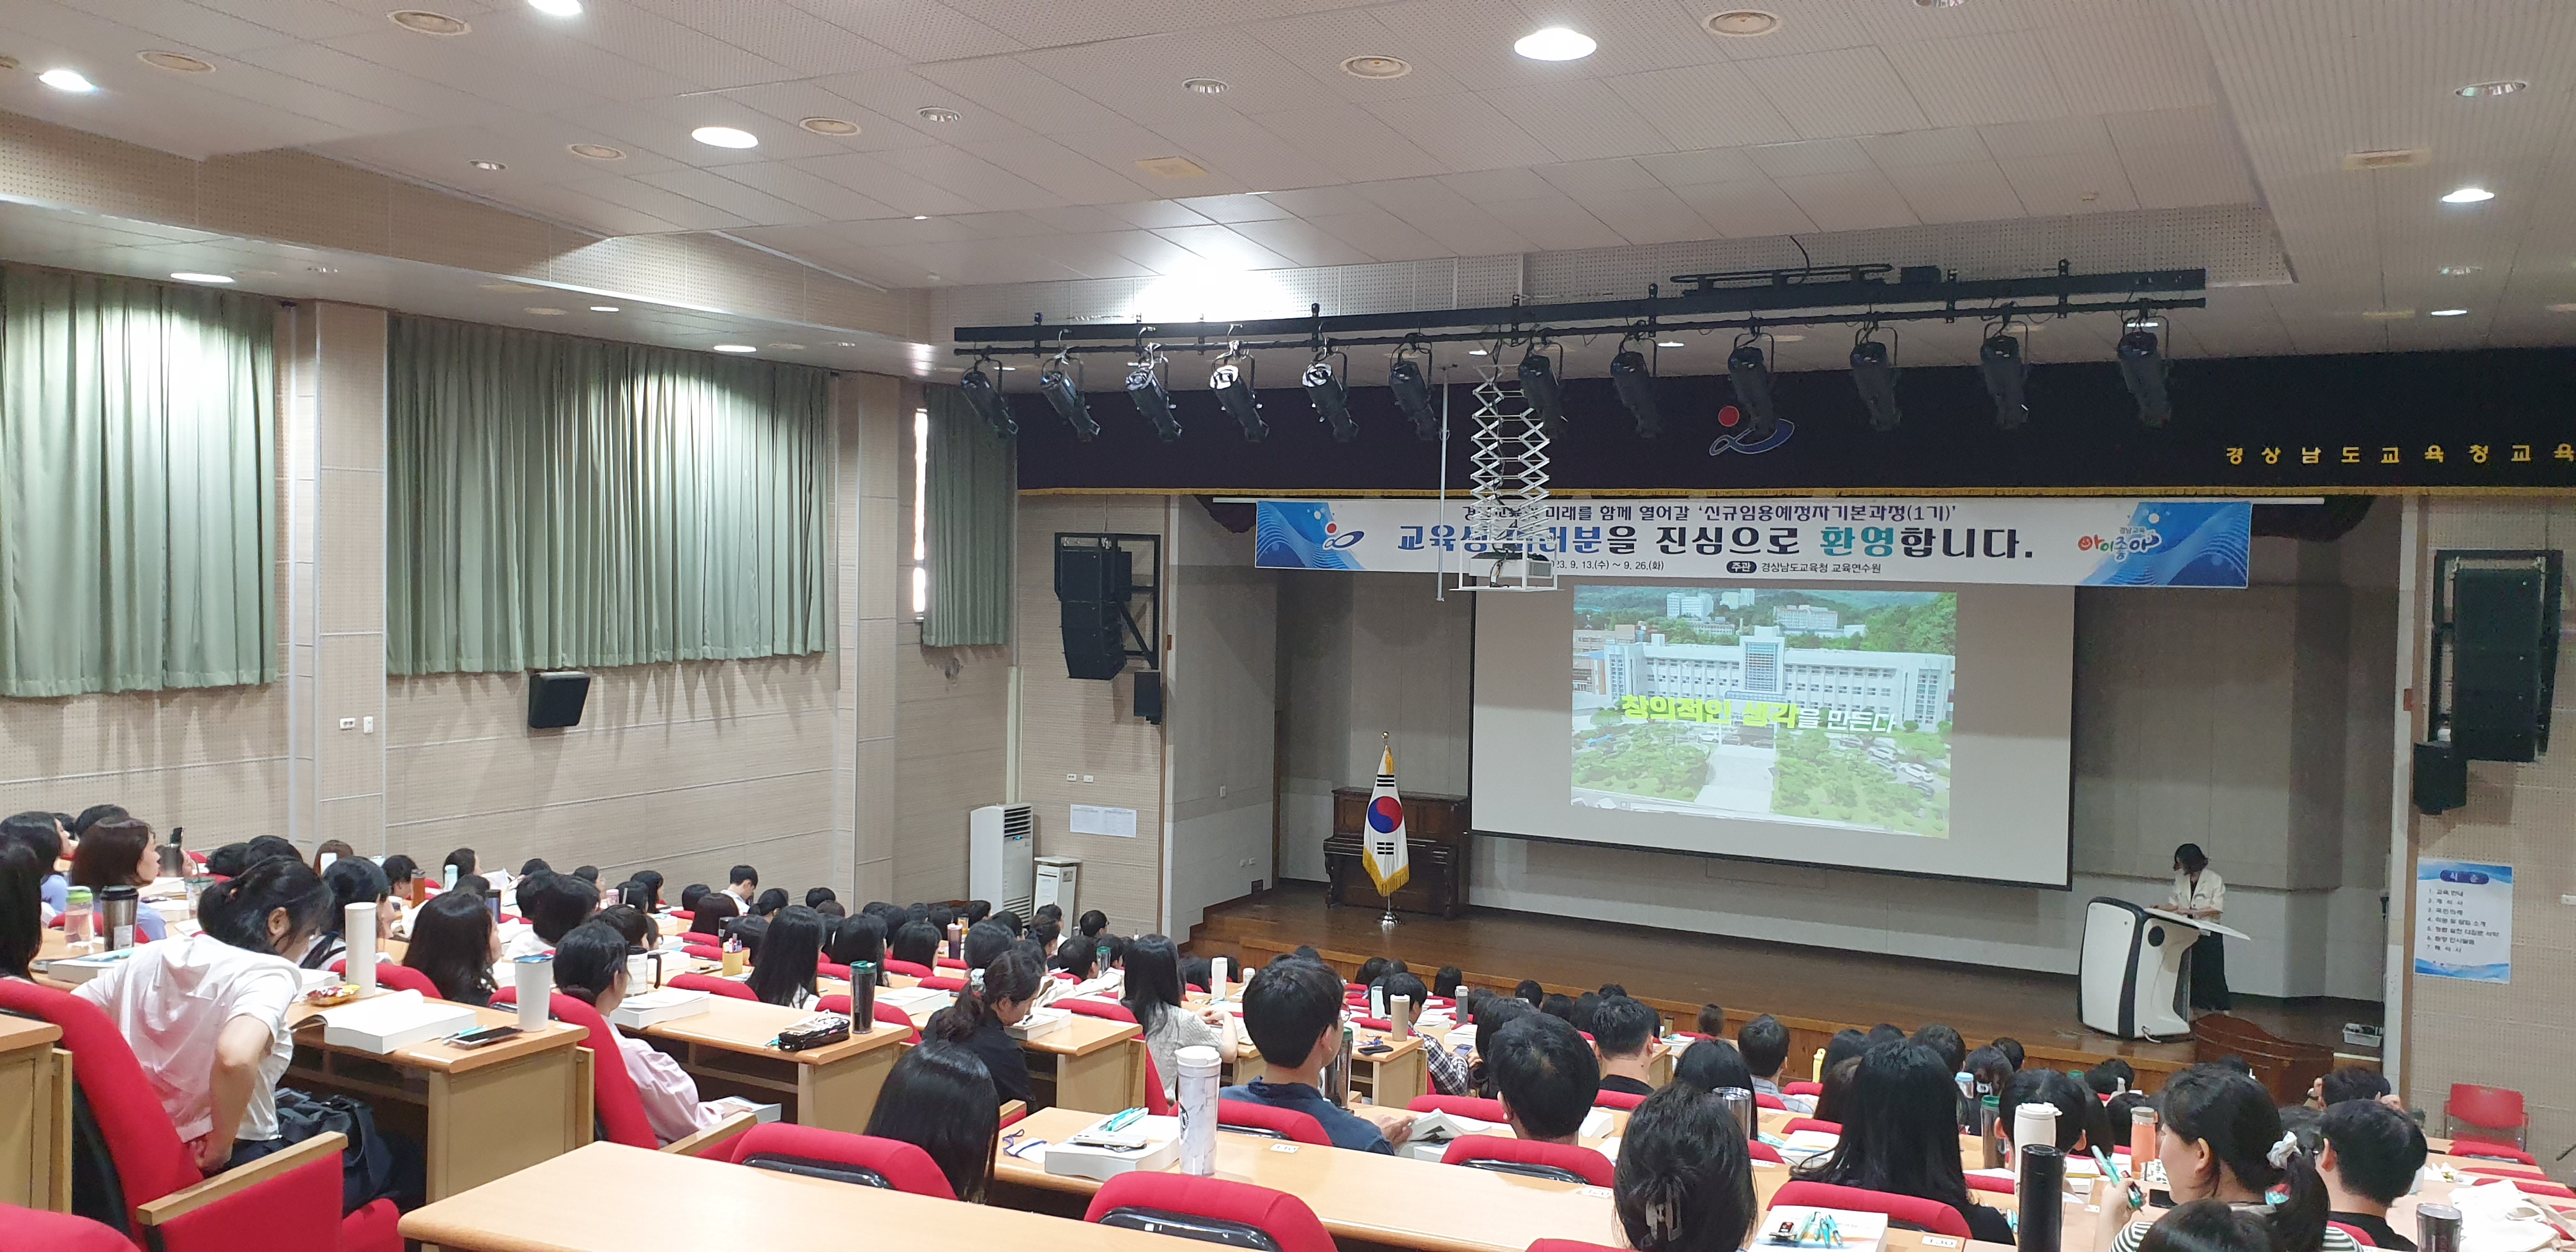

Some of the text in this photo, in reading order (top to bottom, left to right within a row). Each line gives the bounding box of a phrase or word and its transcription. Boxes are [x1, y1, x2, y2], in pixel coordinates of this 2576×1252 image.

[1545, 506, 1593, 521] 미래를
[1599, 505, 1631, 521] 함께
[1639, 505, 1690, 521] 열어갈
[1655, 526, 1800, 556] 진심으로
[1820, 526, 2033, 559] 환영합니다.
[1570, 560, 1578, 569] 9.
[1582, 559, 1609, 570] 13.(수)
[1623, 561, 1632, 570] 9.
[1635, 561, 1664, 572] 26.(화)
[1731, 561, 1882, 574] 주관 경상남도교육청 교육연수원
[1621, 694, 1897, 734] 창의적인 생각을 만든다
